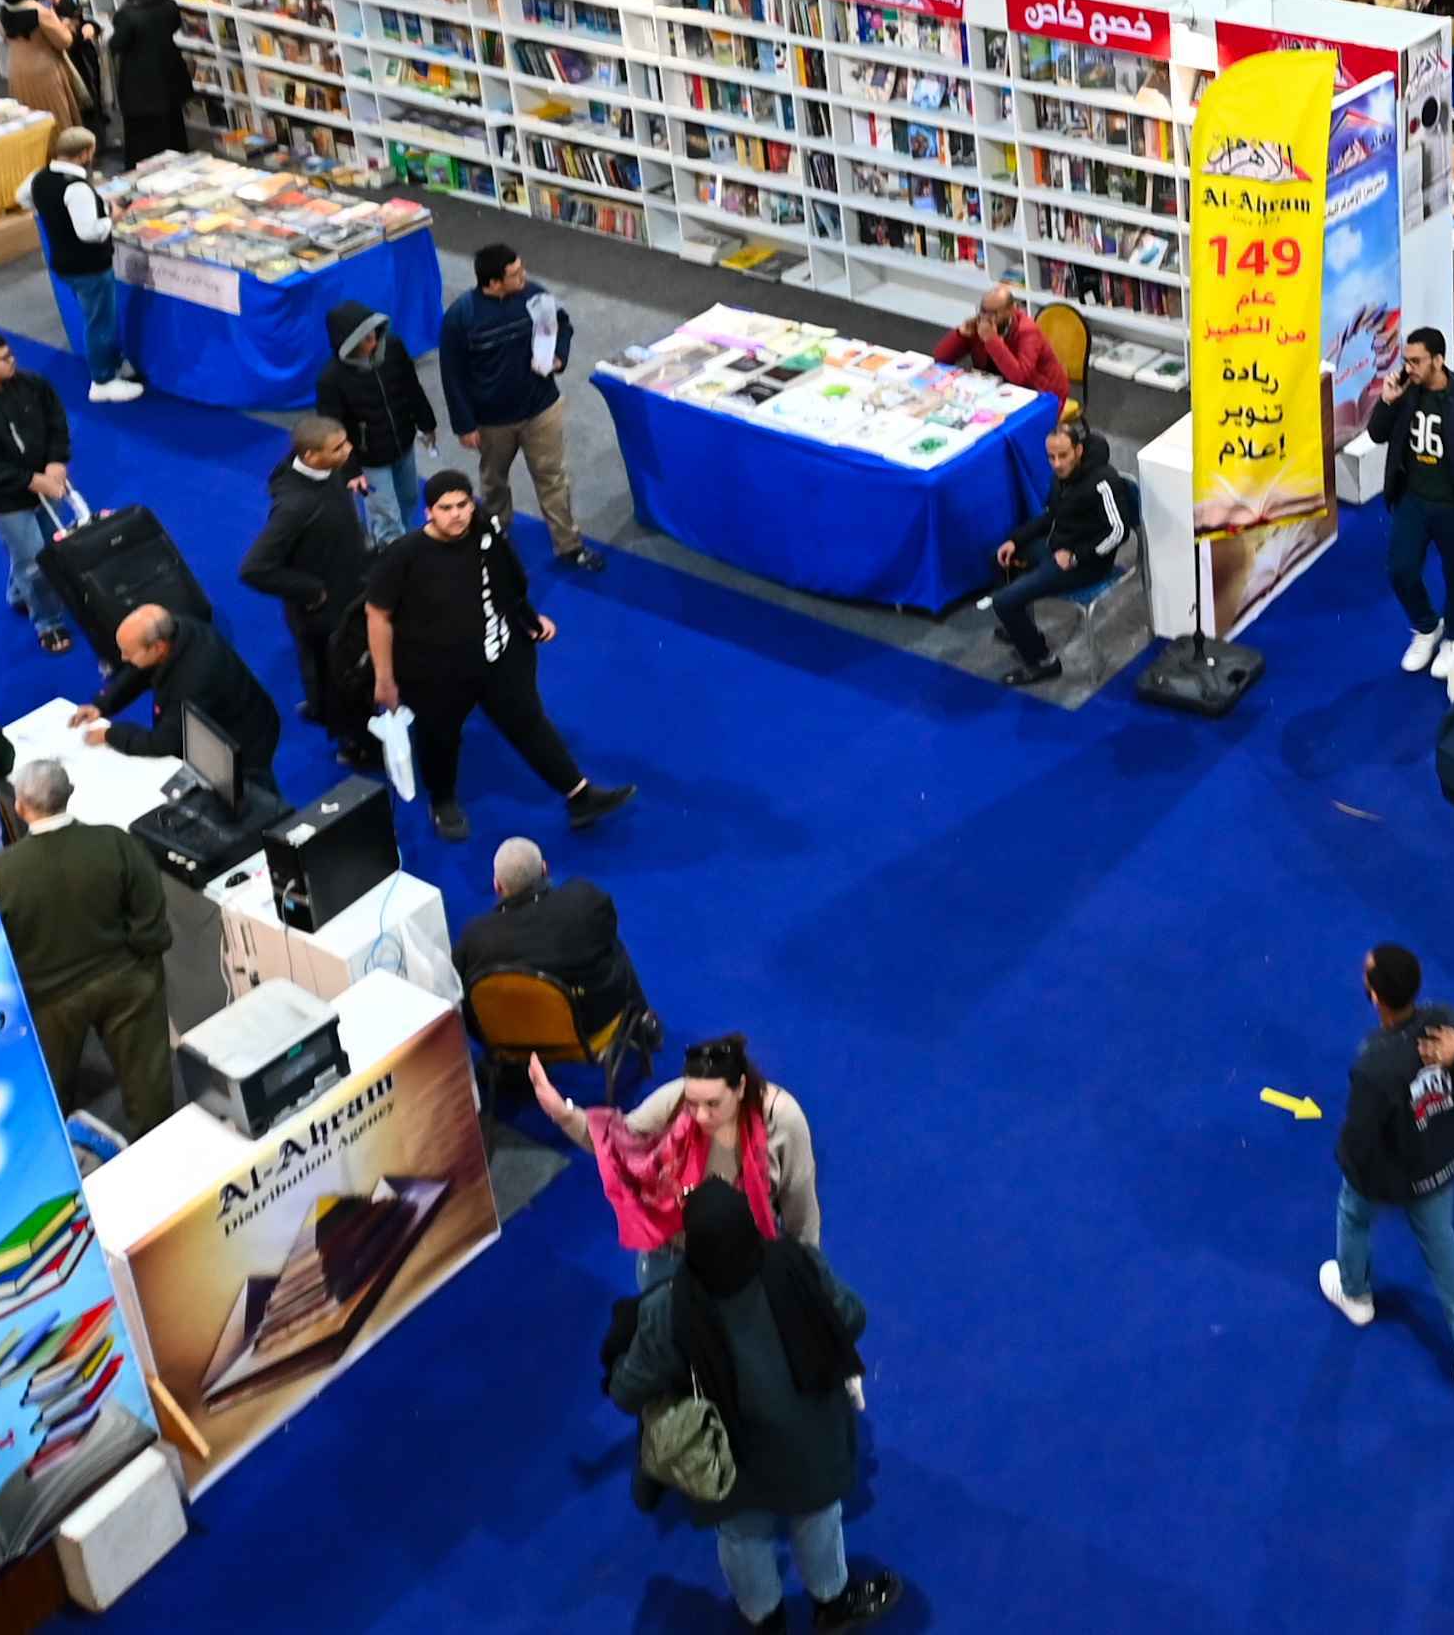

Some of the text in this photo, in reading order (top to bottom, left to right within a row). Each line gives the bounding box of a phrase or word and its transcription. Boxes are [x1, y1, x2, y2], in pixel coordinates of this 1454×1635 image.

[1089, 9, 1152, 45] خصم
[1202, 187, 1310, 218] Al-Ahram
[1208, 235, 1302, 279] 149
[1236, 287, 1277, 315] عام
[1203, 315, 1307, 345] من التميز
[1222, 357, 1280, 395] ريادة
[1217, 403, 1283, 428] تنوير
[1219, 432, 1286, 466] إعلام
[216, 1070, 393, 1222] Al-Ahram
[223, 1098, 395, 1237] Distribution Agency
